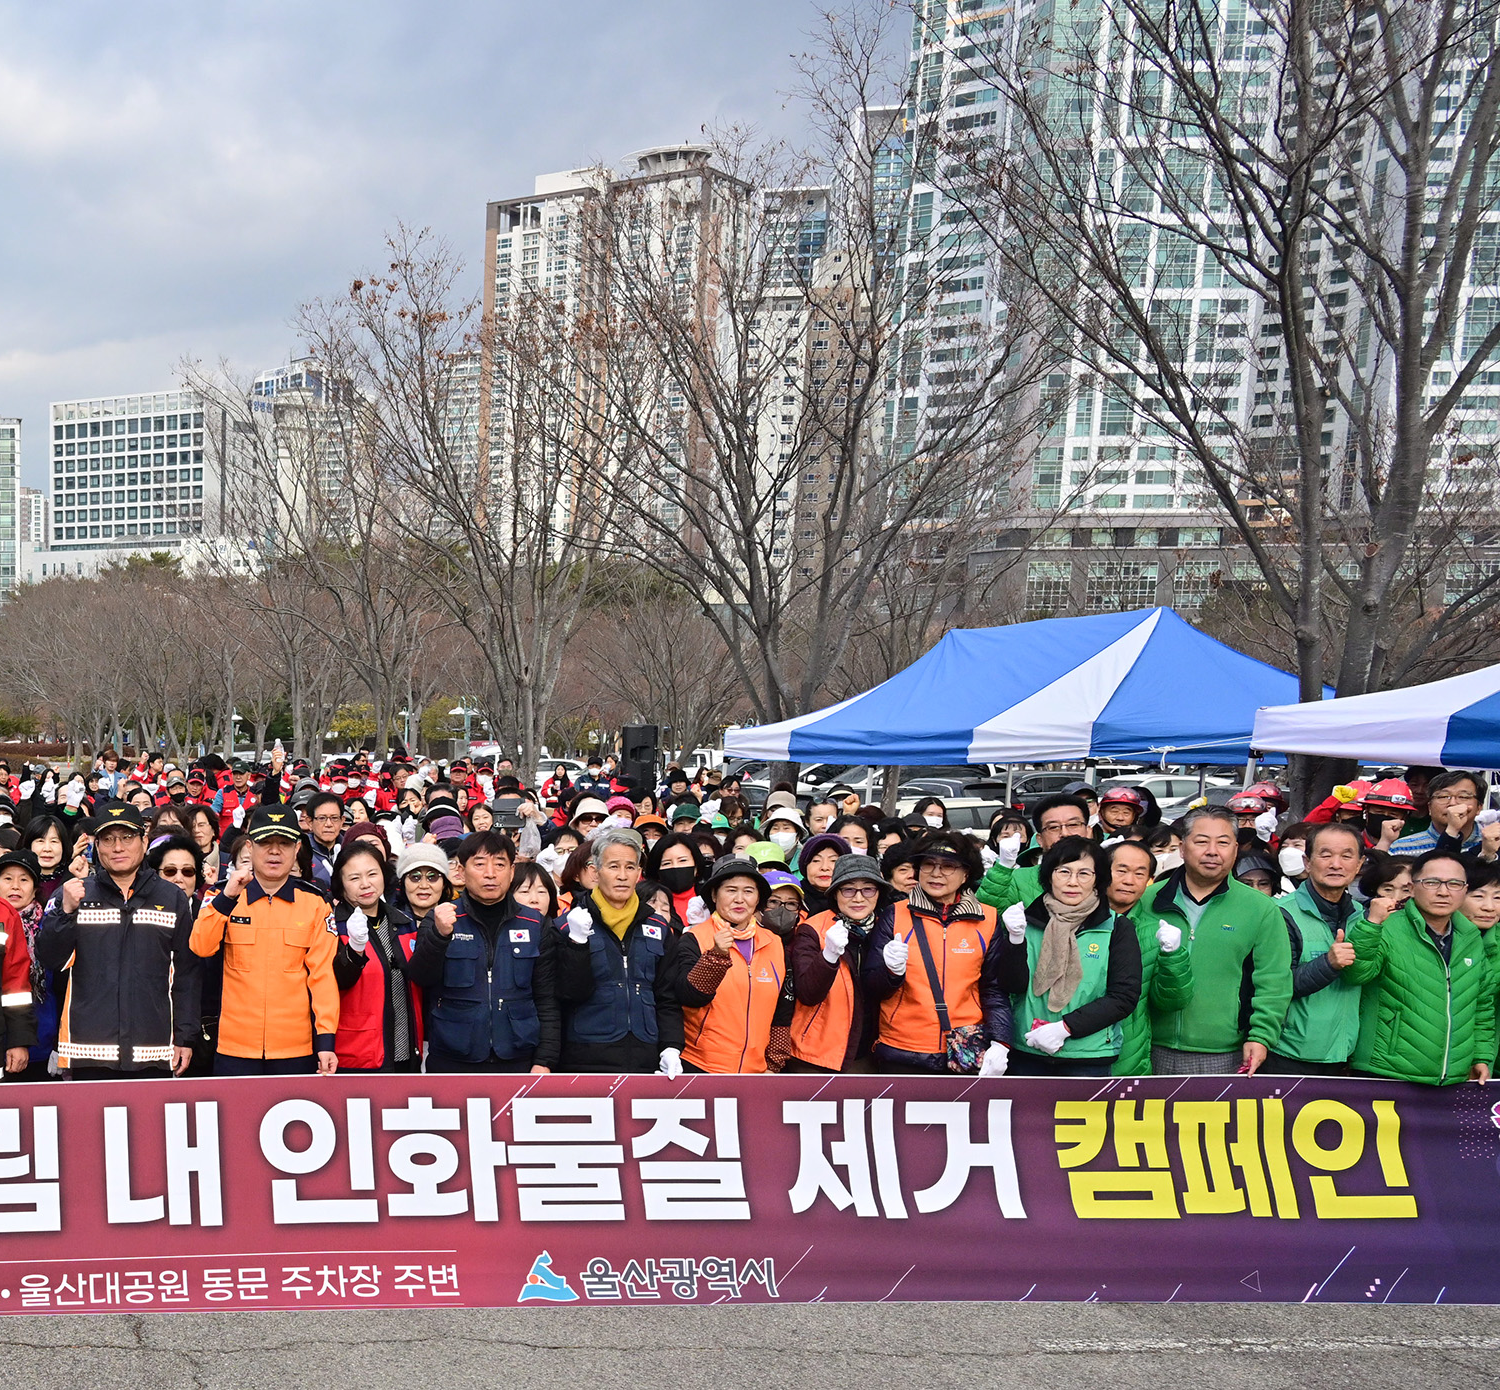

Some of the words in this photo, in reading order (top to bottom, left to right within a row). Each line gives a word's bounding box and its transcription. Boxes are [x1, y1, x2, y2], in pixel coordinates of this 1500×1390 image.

[103, 1101, 224, 1227] 내
[259, 1096, 751, 1224] 인화물질
[782, 1098, 1028, 1220] 제거
[1054, 1098, 1419, 1220] 캠페인
[18, 1270, 191, 1306] 울산대공원
[201, 1267, 269, 1302] 동문
[280, 1264, 382, 1300] 주차장
[393, 1263, 461, 1298] 주변
[580, 1256, 780, 1300] 울산광역시
